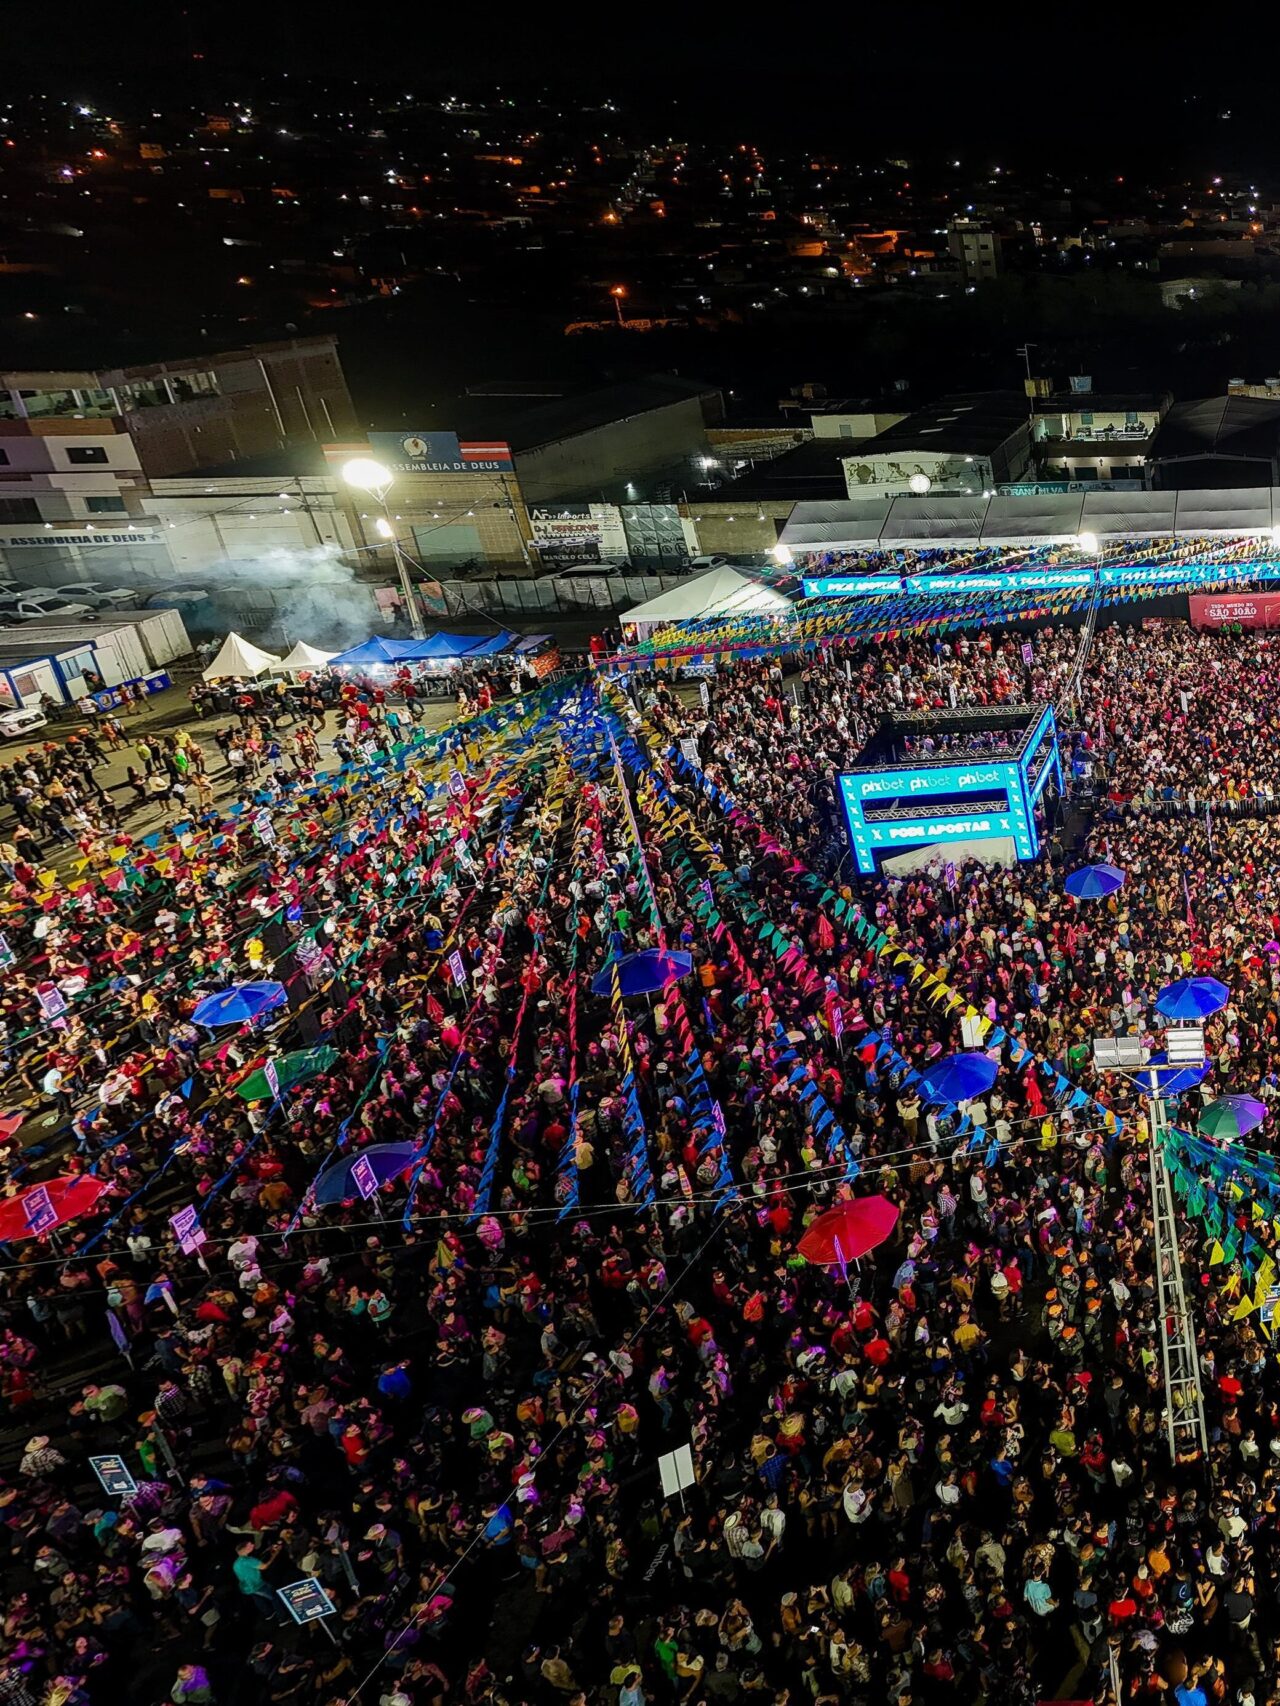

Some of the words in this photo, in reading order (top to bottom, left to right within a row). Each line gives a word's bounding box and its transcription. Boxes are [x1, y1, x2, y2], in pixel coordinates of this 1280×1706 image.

[453, 461, 467, 470] DE
[471, 461, 500, 470] DEUS
[10, 535, 92, 546] ASSEMBLEIA
[93, 535, 110, 543] DE
[112, 533, 146, 543] DEUS
[861, 779, 905, 796] pixbet
[910, 775, 951, 792] pixbet
[958, 769, 1000, 788] pixbet
[927, 820, 991, 836] APOSTAR
